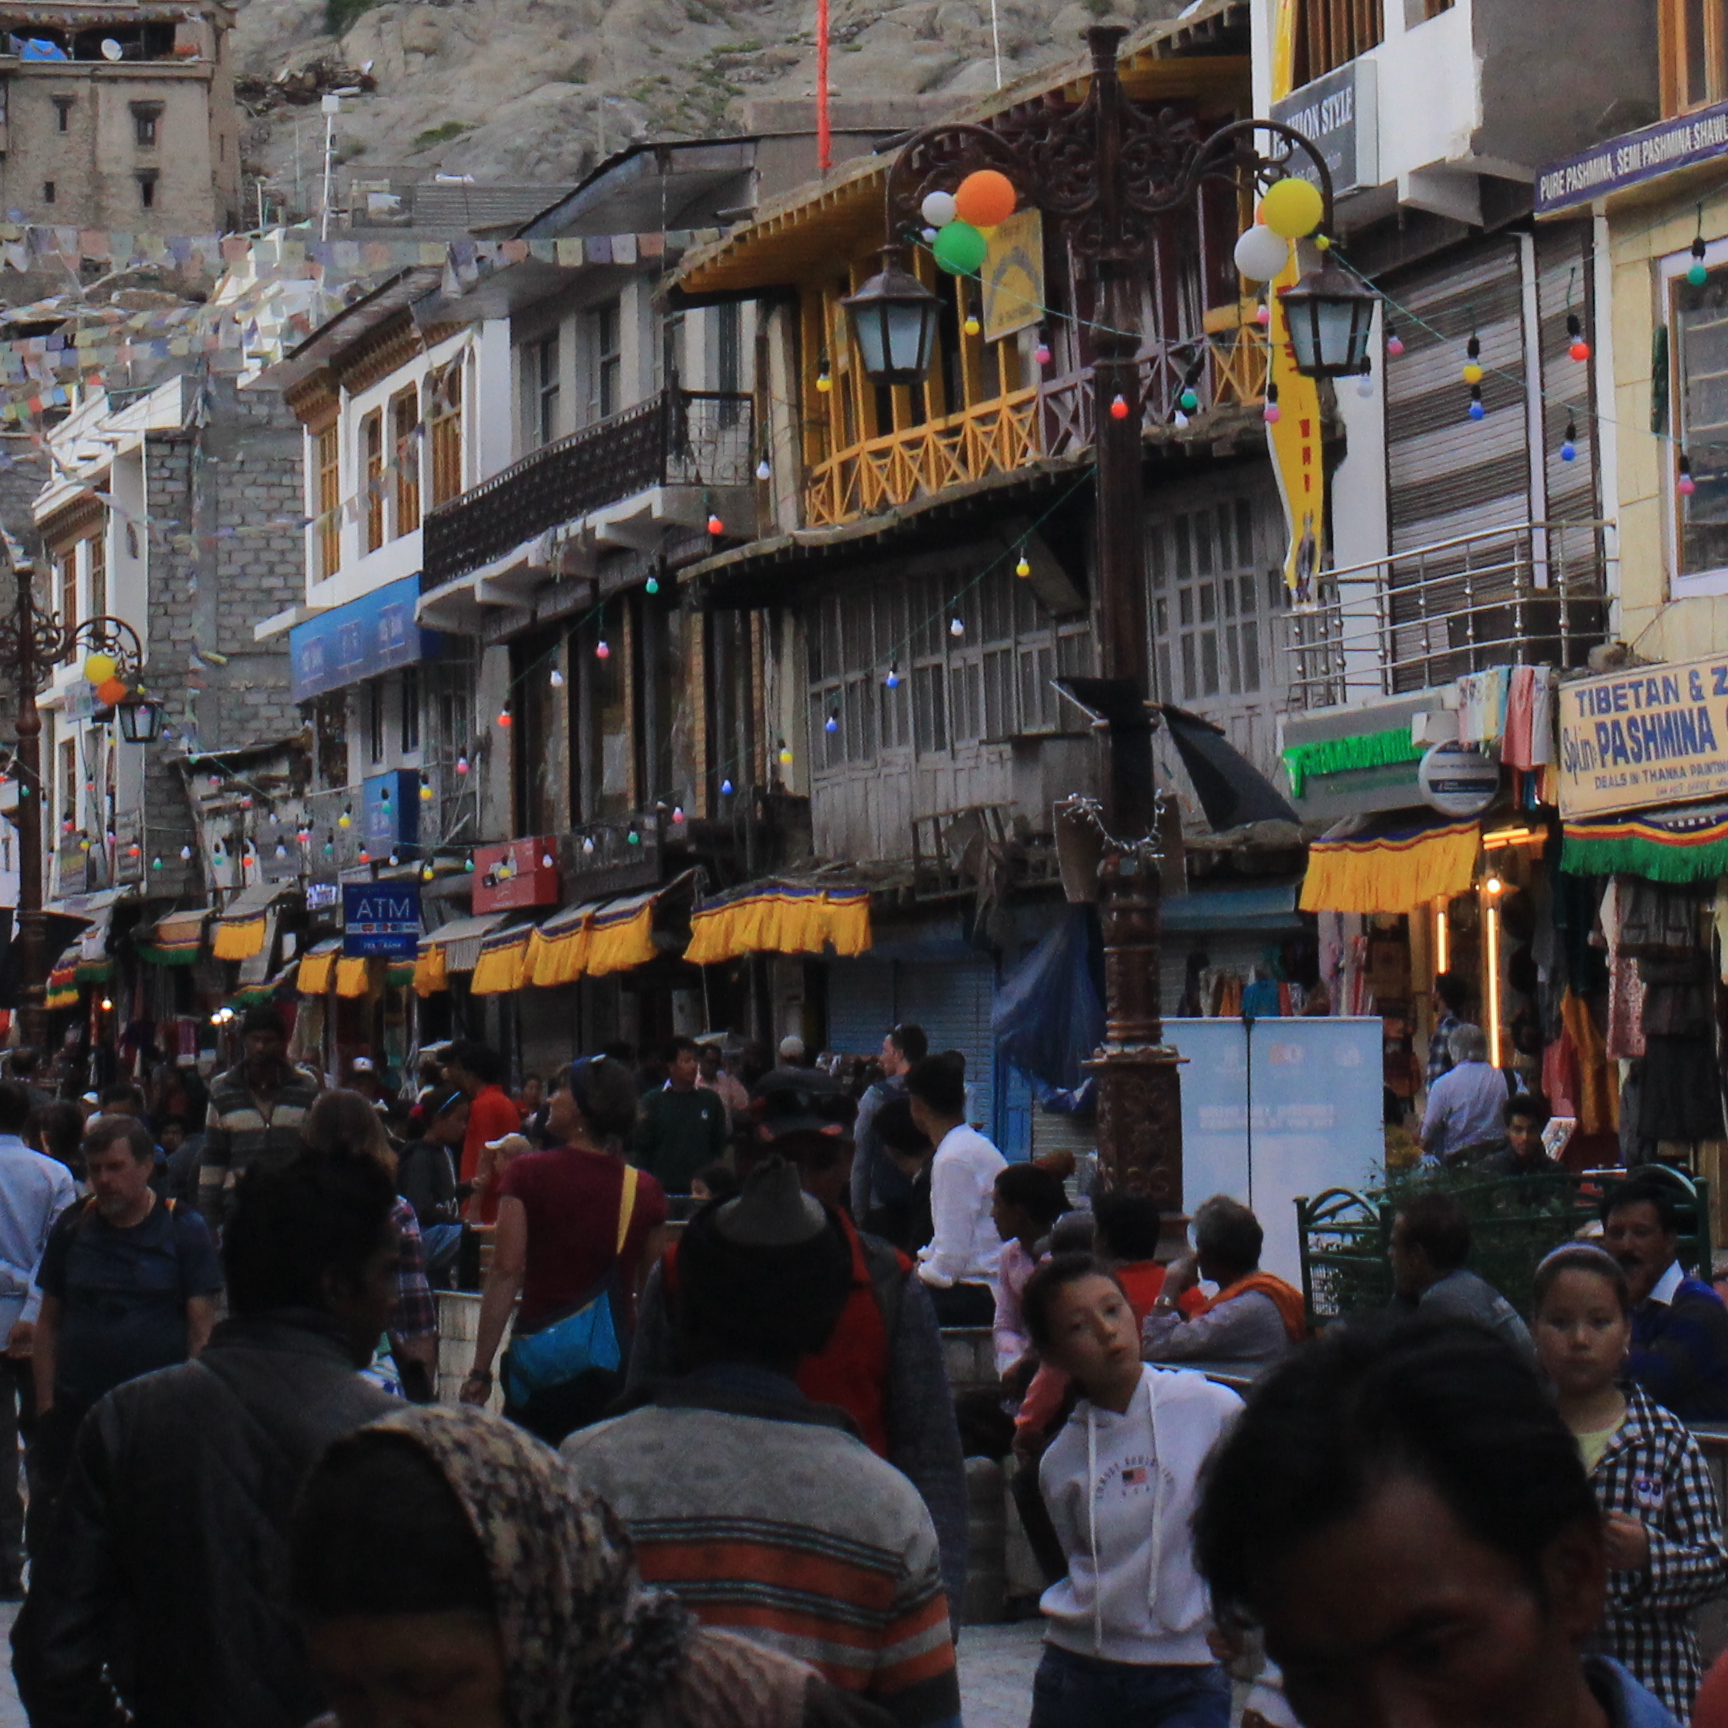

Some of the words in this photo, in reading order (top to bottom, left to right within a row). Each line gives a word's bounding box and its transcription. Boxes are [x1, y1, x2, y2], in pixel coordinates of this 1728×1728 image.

[1540, 170, 1565, 202] PURE
[1566, 153, 1616, 192] PASHMINA,
[1617, 145, 1642, 175] SEMI
[1642, 125, 1693, 164] PASHMINA
[1574, 673, 1680, 718] TIBETAN
[1688, 669, 1705, 703] &
[1594, 705, 1718, 769] PASHMINA
[1594, 776, 1628, 791] DEALS
[1630, 774, 1640, 786] IN
[1642, 767, 1687, 784] THANKA
[356, 897, 411, 920] ATM
